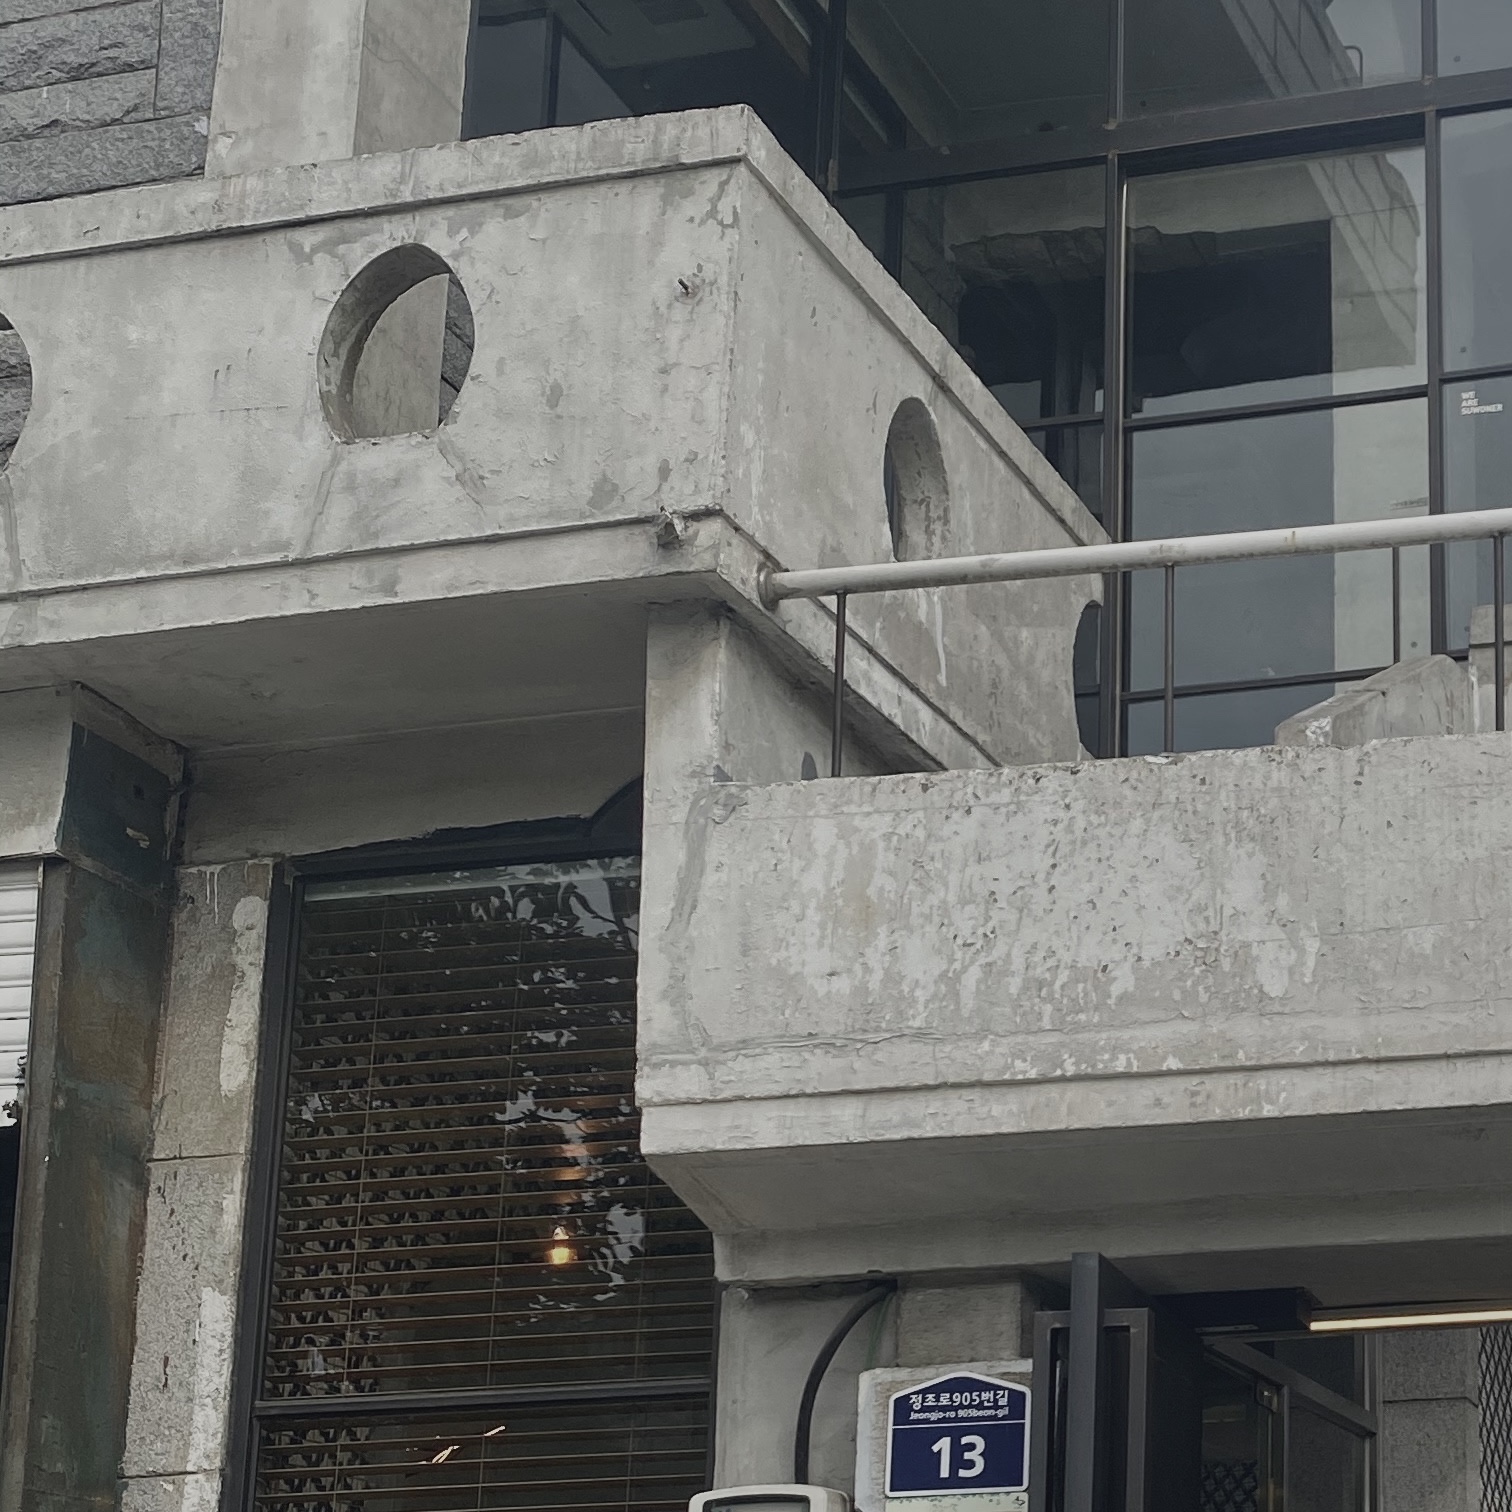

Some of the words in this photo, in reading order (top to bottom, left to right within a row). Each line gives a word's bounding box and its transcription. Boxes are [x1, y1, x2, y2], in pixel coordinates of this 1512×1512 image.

[1461, 391, 1476, 400] WE
[1461, 398, 1479, 407] ARE
[1461, 403, 1504, 415] SUWONER
[908, 1389, 1009, 1411] 정조로905번길
[909, 1410, 956, 1421] Jeongjo-ro
[931, 1434, 986, 1479] 13
